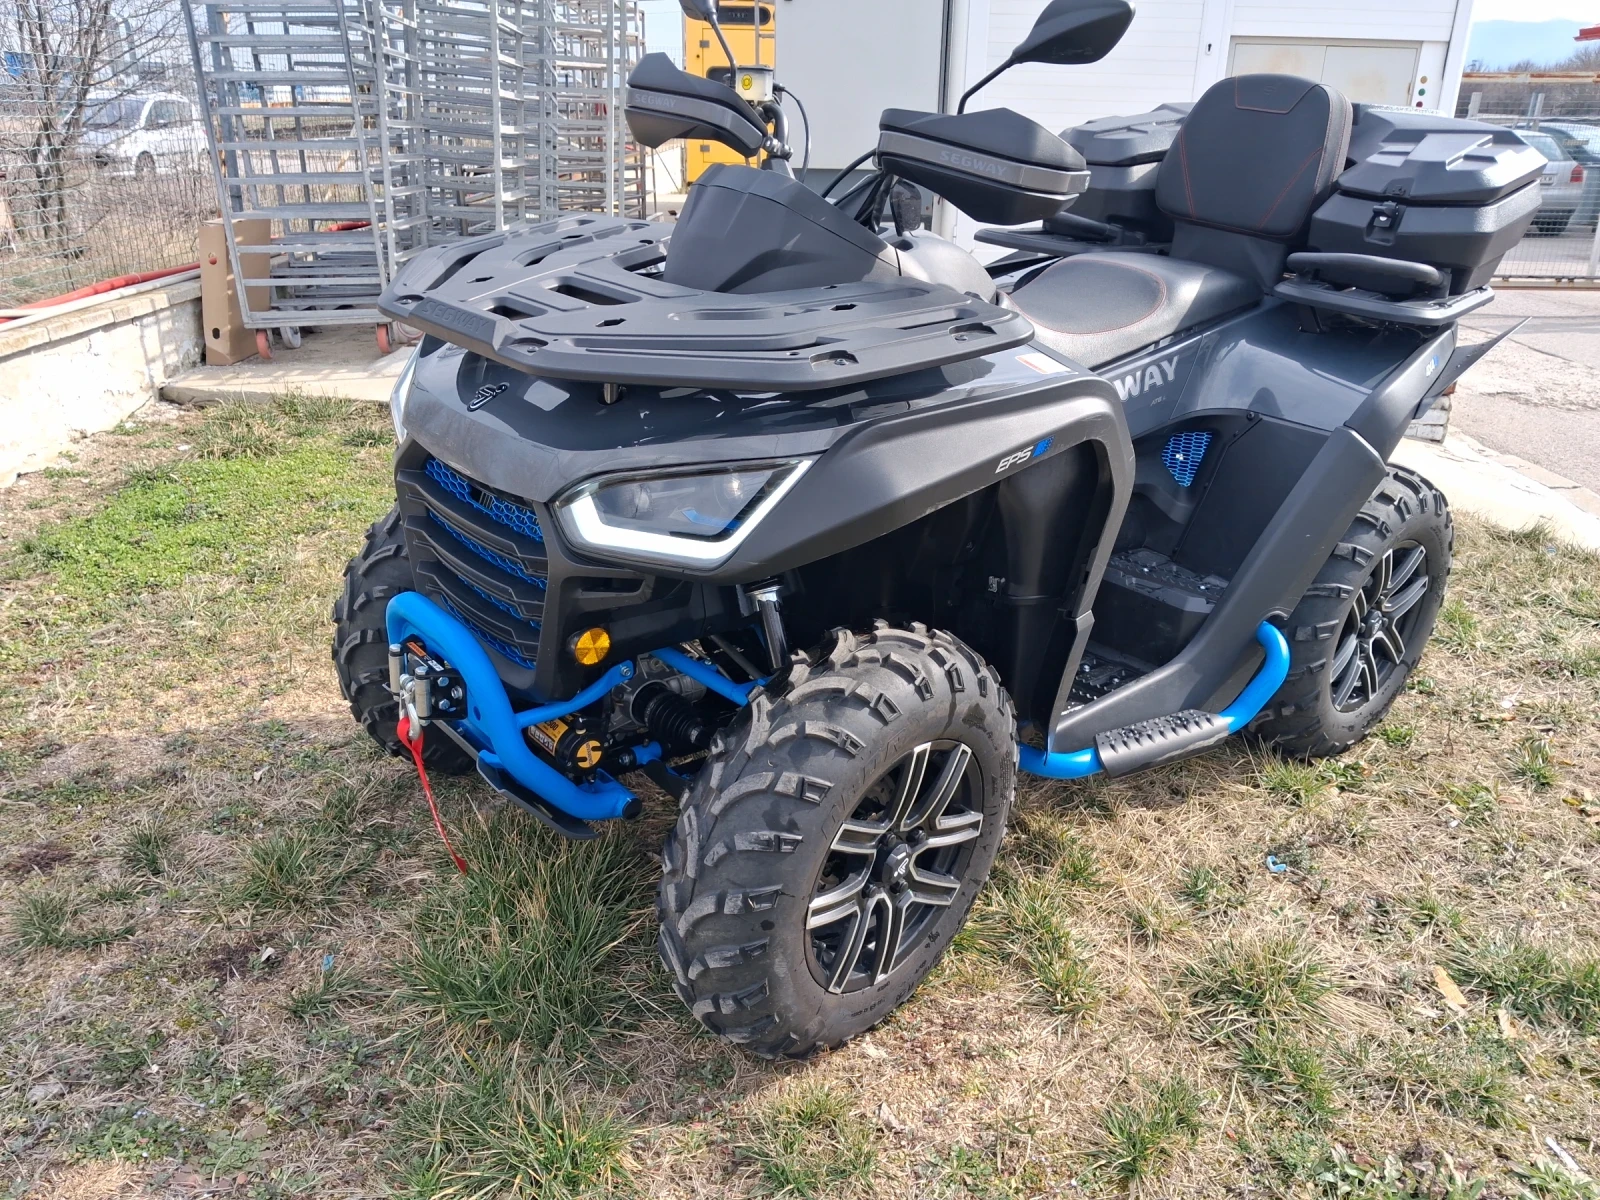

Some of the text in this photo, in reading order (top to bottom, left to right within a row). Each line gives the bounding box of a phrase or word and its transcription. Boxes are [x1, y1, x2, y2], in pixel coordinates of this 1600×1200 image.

[634, 93, 677, 109] SEGWAY
[939, 150, 1007, 177] SEGWAY
[421, 301, 489, 334] SEGWAY
[995, 446, 1033, 474] EPS
